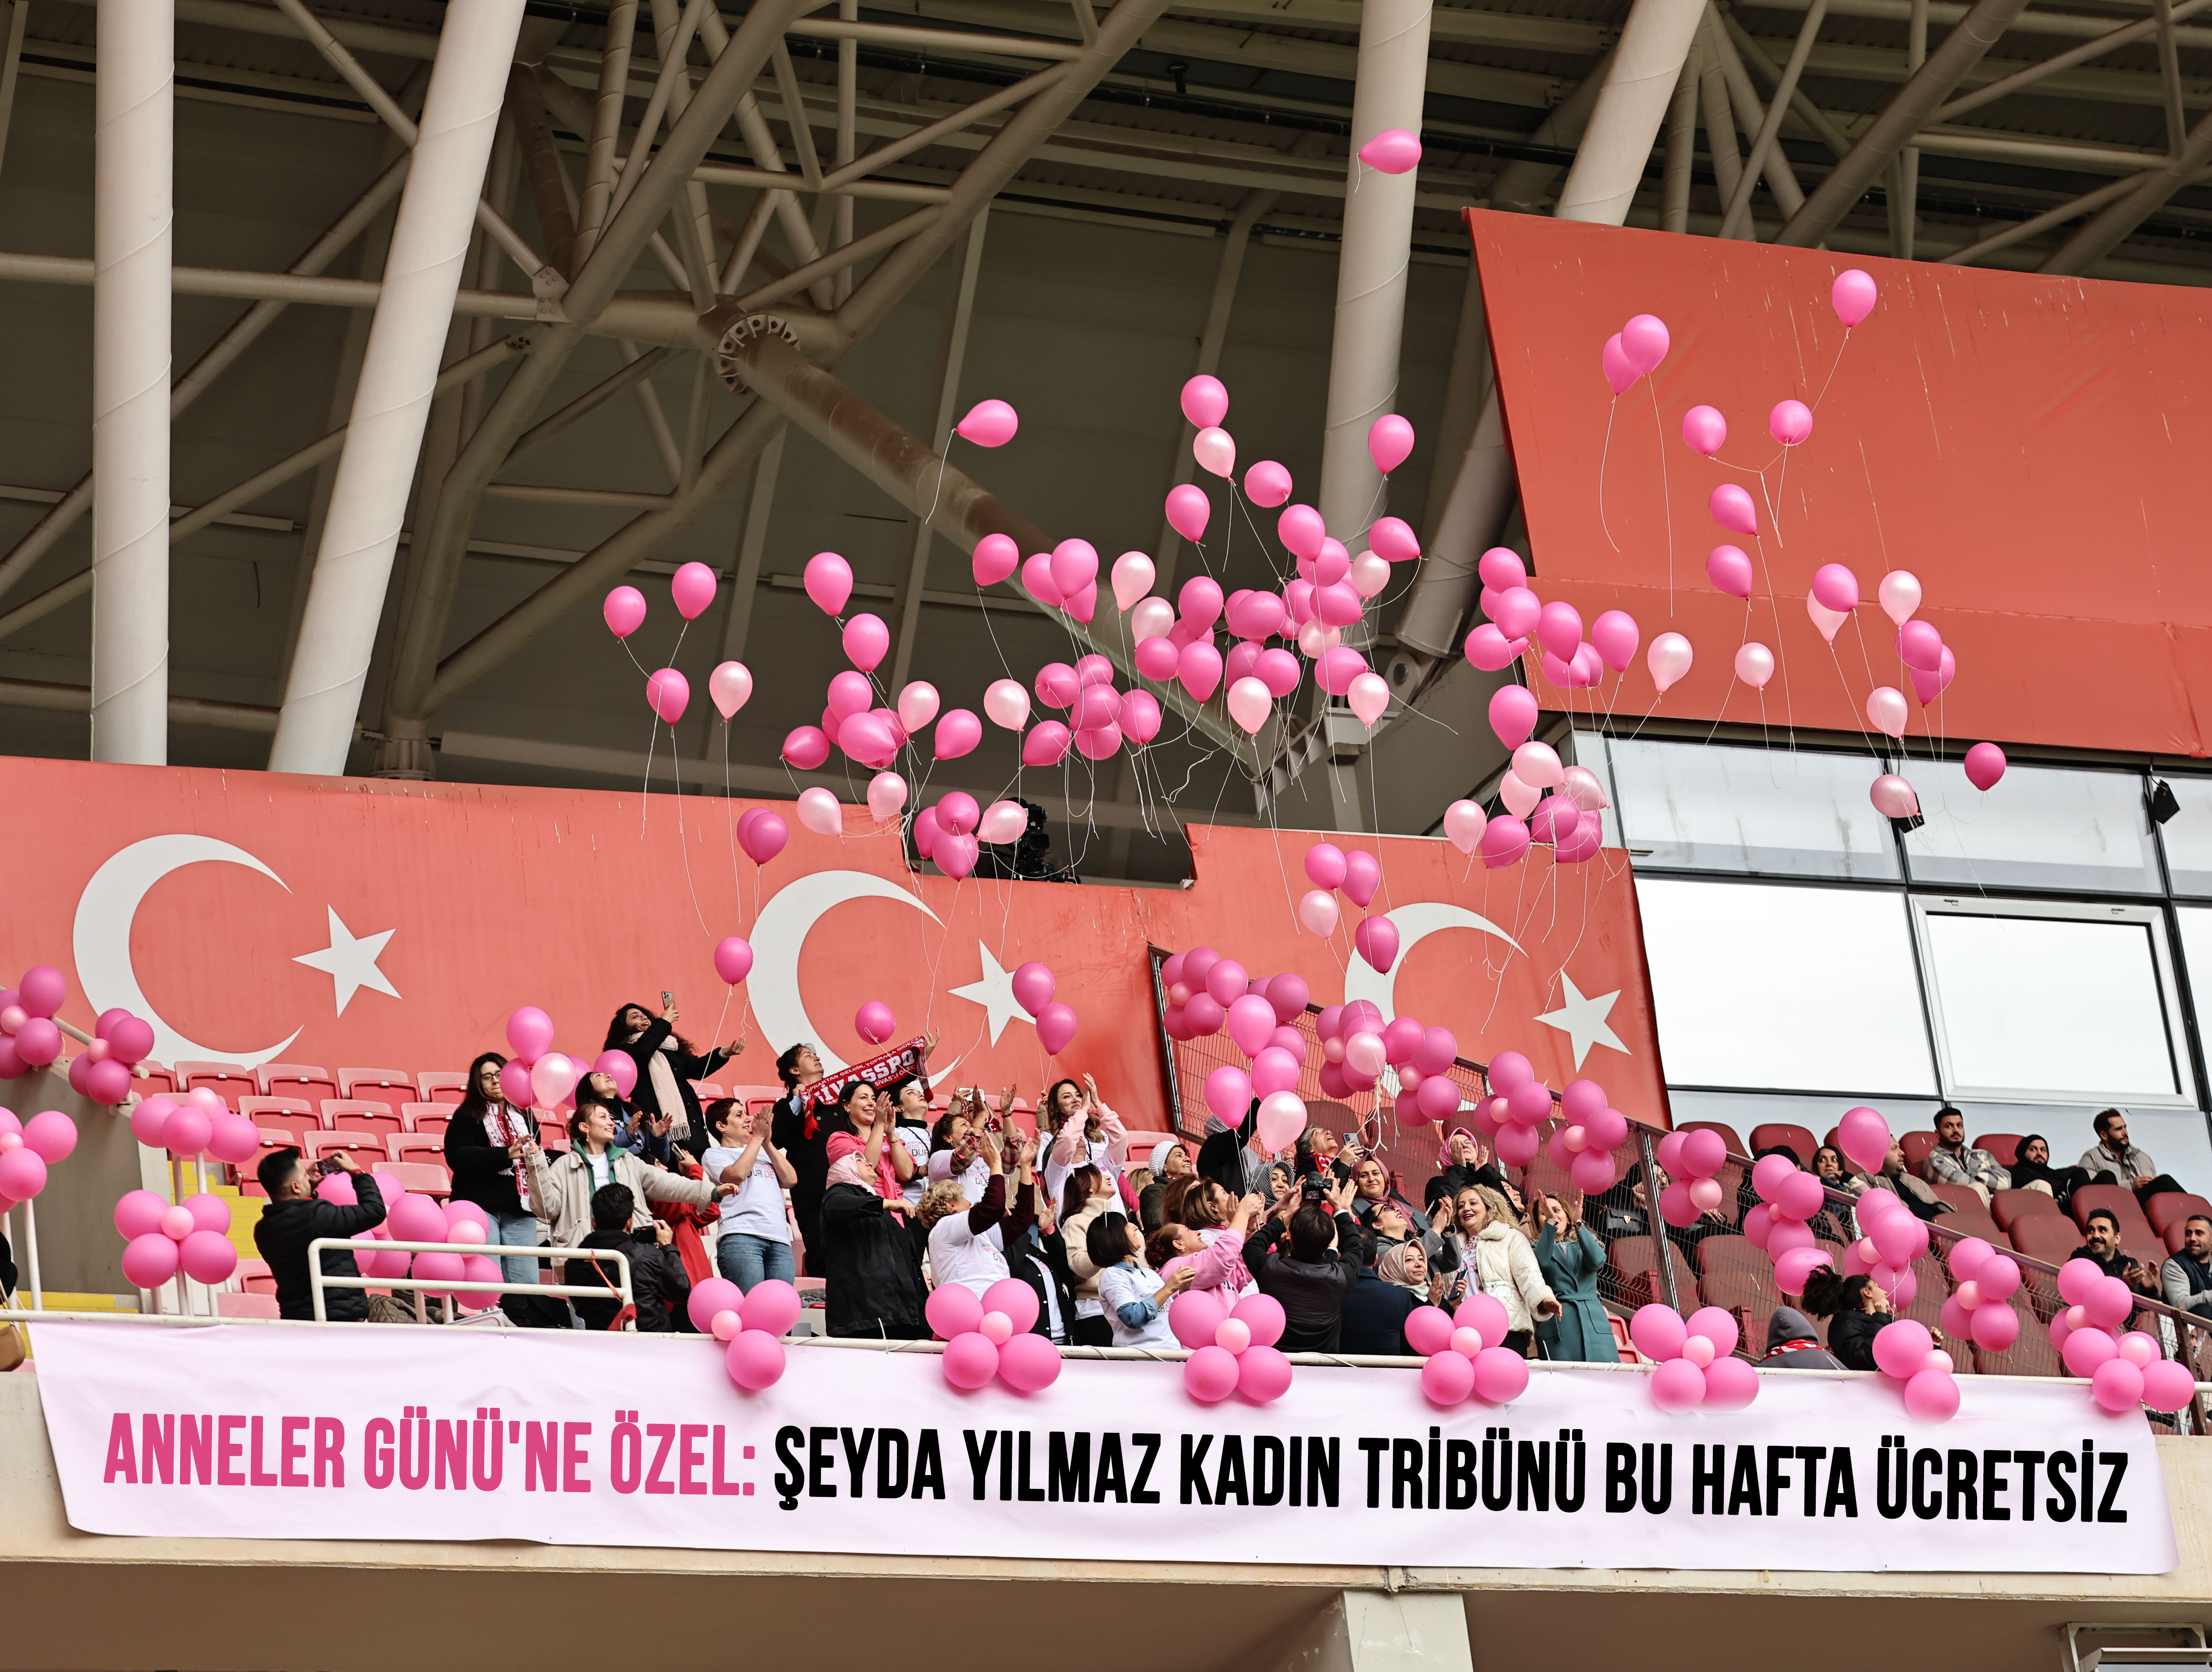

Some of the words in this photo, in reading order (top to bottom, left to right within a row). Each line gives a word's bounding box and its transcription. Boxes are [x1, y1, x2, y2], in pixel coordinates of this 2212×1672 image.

[806, 1074, 839, 1093] OPRAKTAN
[813, 1050, 915, 1104] SİVASSPO
[104, 1413, 344, 1487] ANNELER
[364, 1406, 591, 1492] GÜNÜ'NE
[611, 1410, 755, 1496] ÖZEL:
[775, 1426, 945, 1510] ŞEYDA
[963, 1430, 1160, 1504] YILMAZ
[1180, 1434, 1340, 1507] KADIN
[1358, 1426, 1585, 1512] TRİBÜNÜ
[1606, 1443, 1672, 1514] BU
[1692, 1444, 1858, 1517] HAFTA
[1877, 1435, 2128, 1522] ÜCRETSİZ
